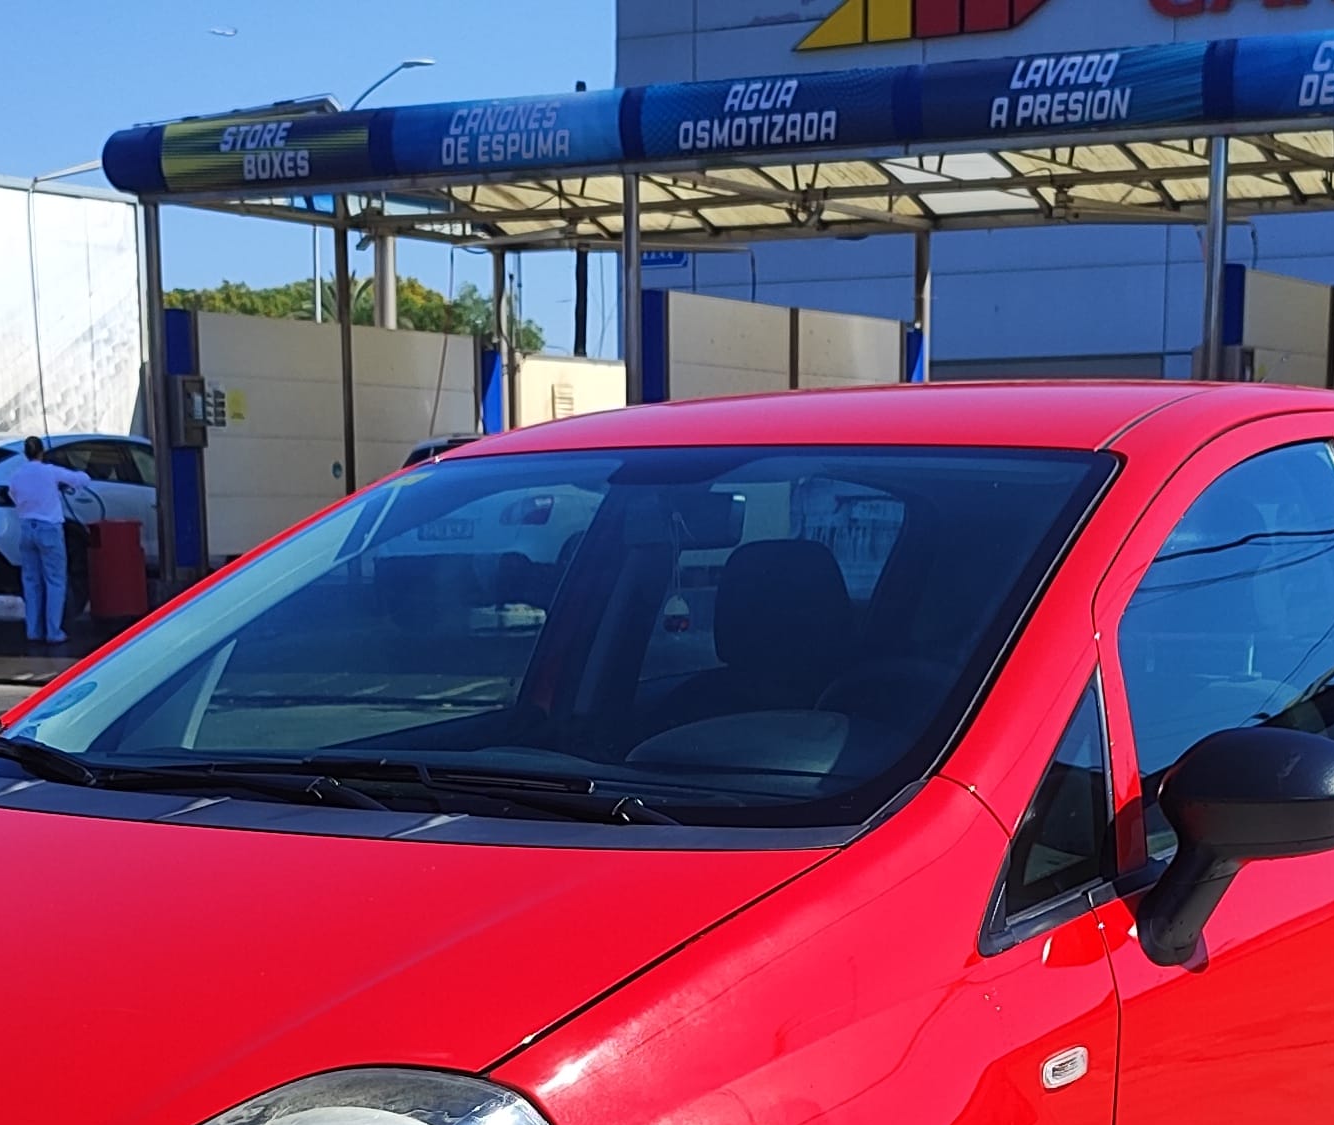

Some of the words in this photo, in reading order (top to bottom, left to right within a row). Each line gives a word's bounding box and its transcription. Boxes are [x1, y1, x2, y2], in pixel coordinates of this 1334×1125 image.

[1010, 53, 1120, 89] LAVADO
[723, 79, 798, 112] AGUA
[990, 97, 1009, 128] A
[219, 121, 293, 152] STORE
[678, 110, 836, 149] OSMOTIZADA
[442, 136, 470, 165] DE
[478, 129, 570, 163] ESPUMA
[243, 150, 310, 180] BOXES
